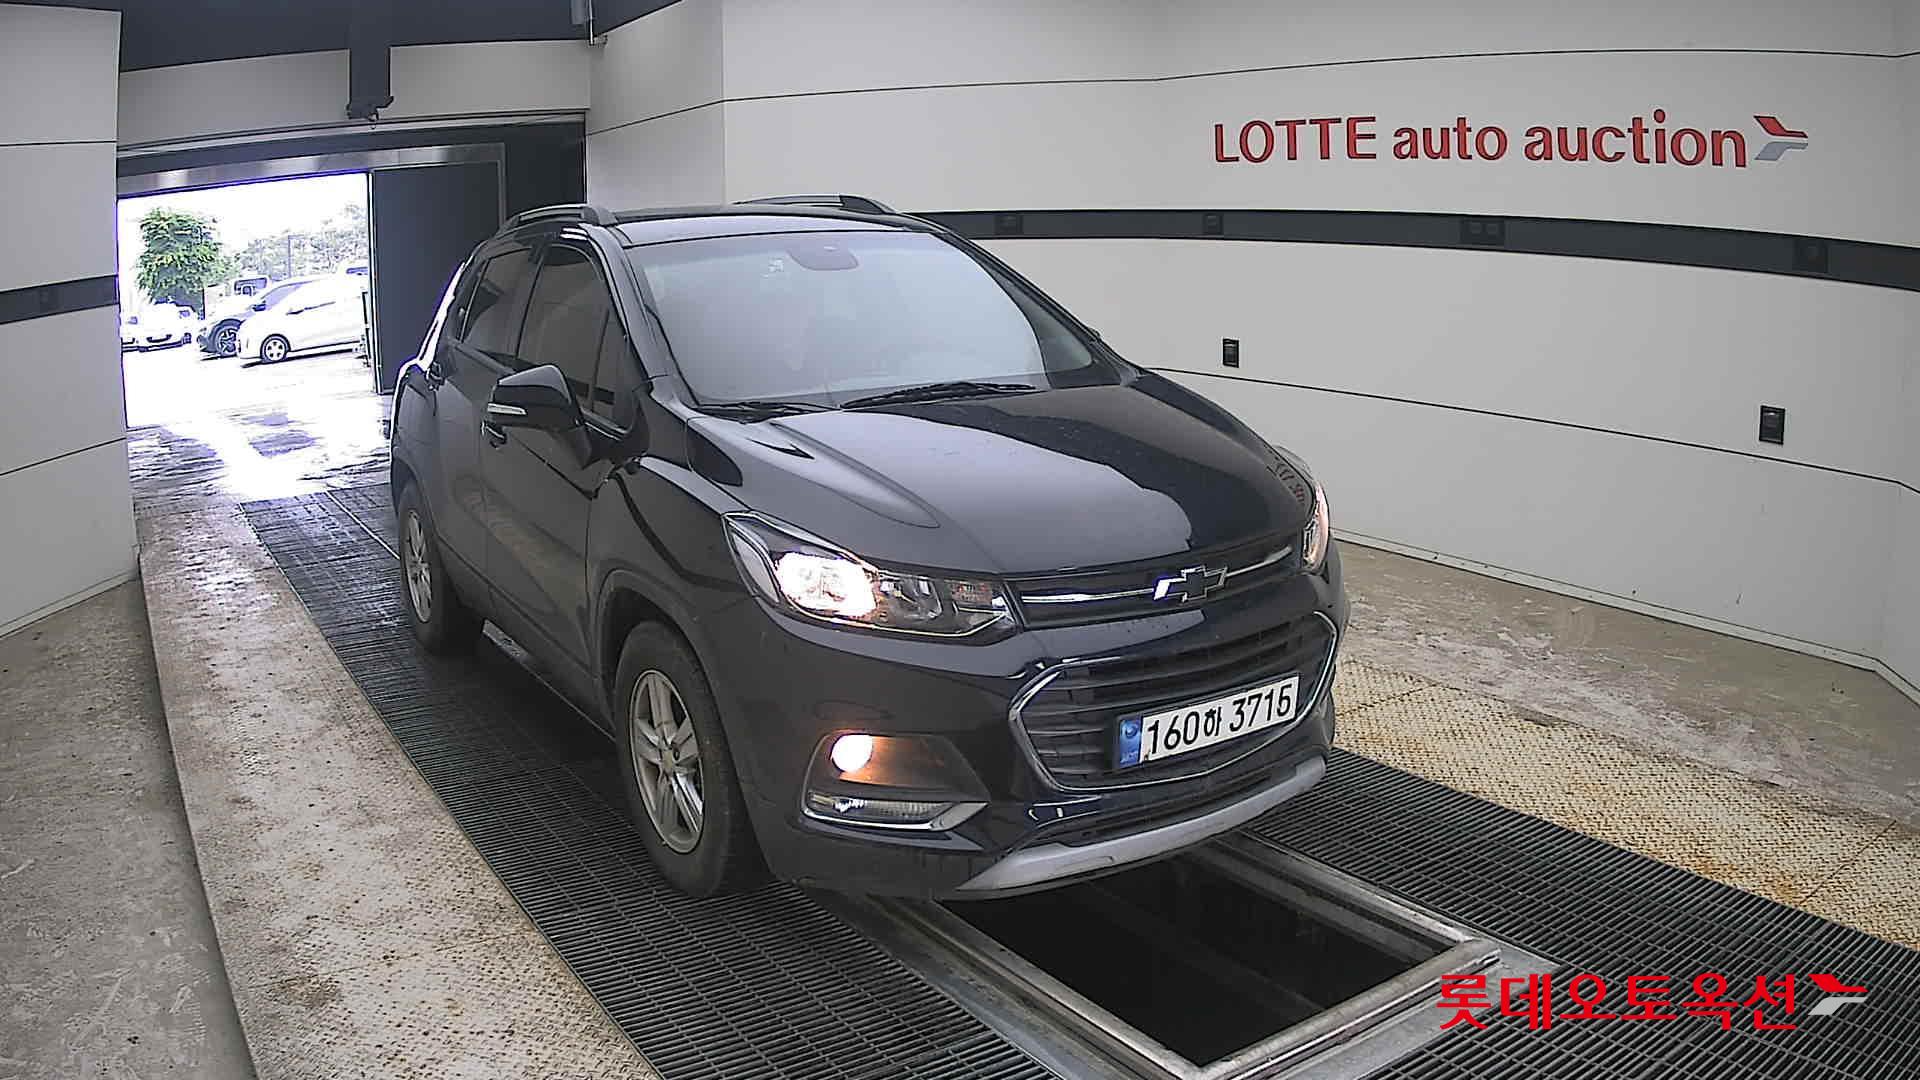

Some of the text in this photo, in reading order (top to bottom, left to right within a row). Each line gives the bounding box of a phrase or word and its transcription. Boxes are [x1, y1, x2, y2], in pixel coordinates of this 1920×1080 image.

[1214, 108, 1747, 169] LOTTE auto auction
[1147, 683, 1293, 755] 160하 3715
